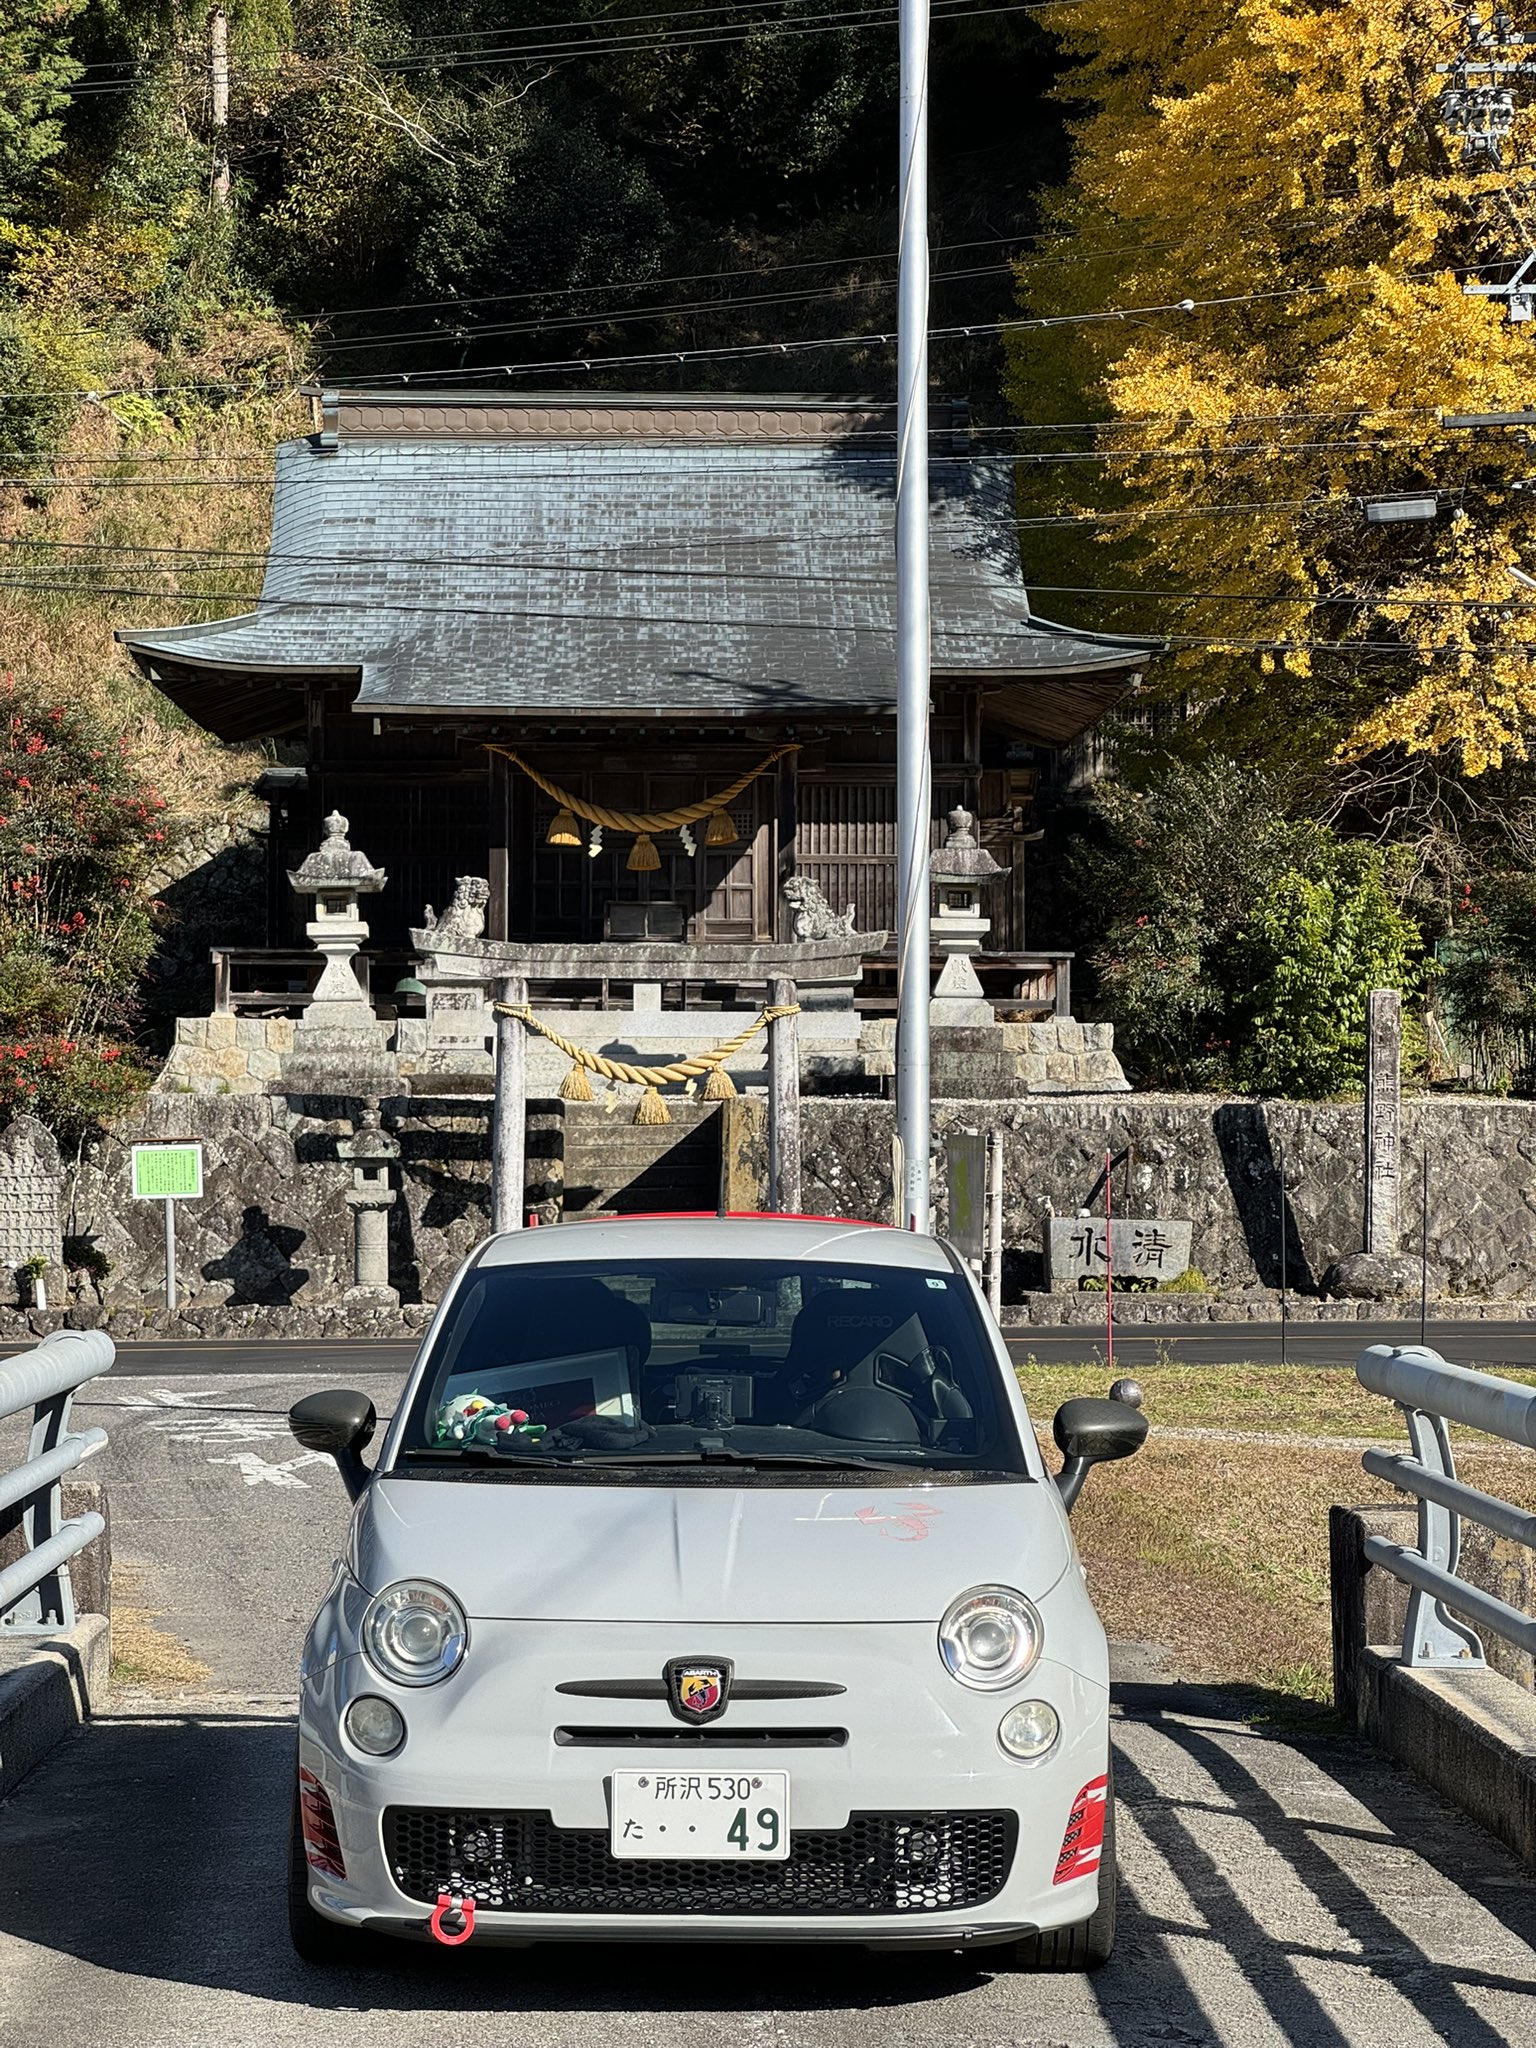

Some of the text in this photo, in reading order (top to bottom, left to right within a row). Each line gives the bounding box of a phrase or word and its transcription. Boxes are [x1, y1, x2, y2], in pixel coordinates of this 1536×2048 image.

[827, 1315, 894, 1329] RECARO
[683, 1669, 718, 1677] ABARTH
[655, 1776, 751, 1800] 所沢 530
[623, 1818, 644, 1839] た
[727, 1807, 779, 1851] 49
